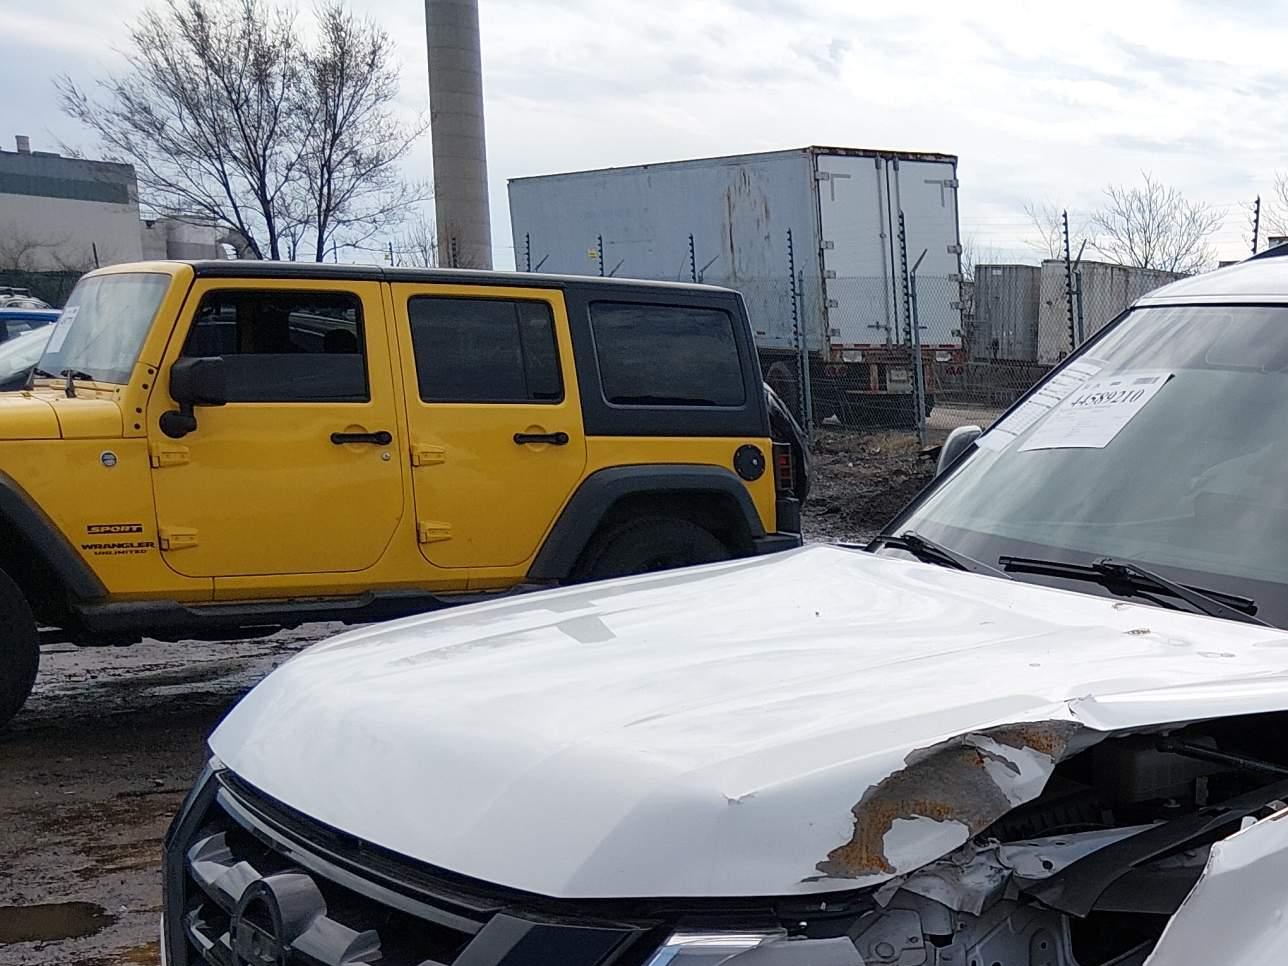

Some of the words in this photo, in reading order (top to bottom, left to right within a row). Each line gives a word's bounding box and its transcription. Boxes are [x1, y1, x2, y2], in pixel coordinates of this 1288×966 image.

[1071, 388, 1146, 408] 44589210
[89, 525, 143, 533] SPORT
[81, 541, 156, 550] WRANGLER
